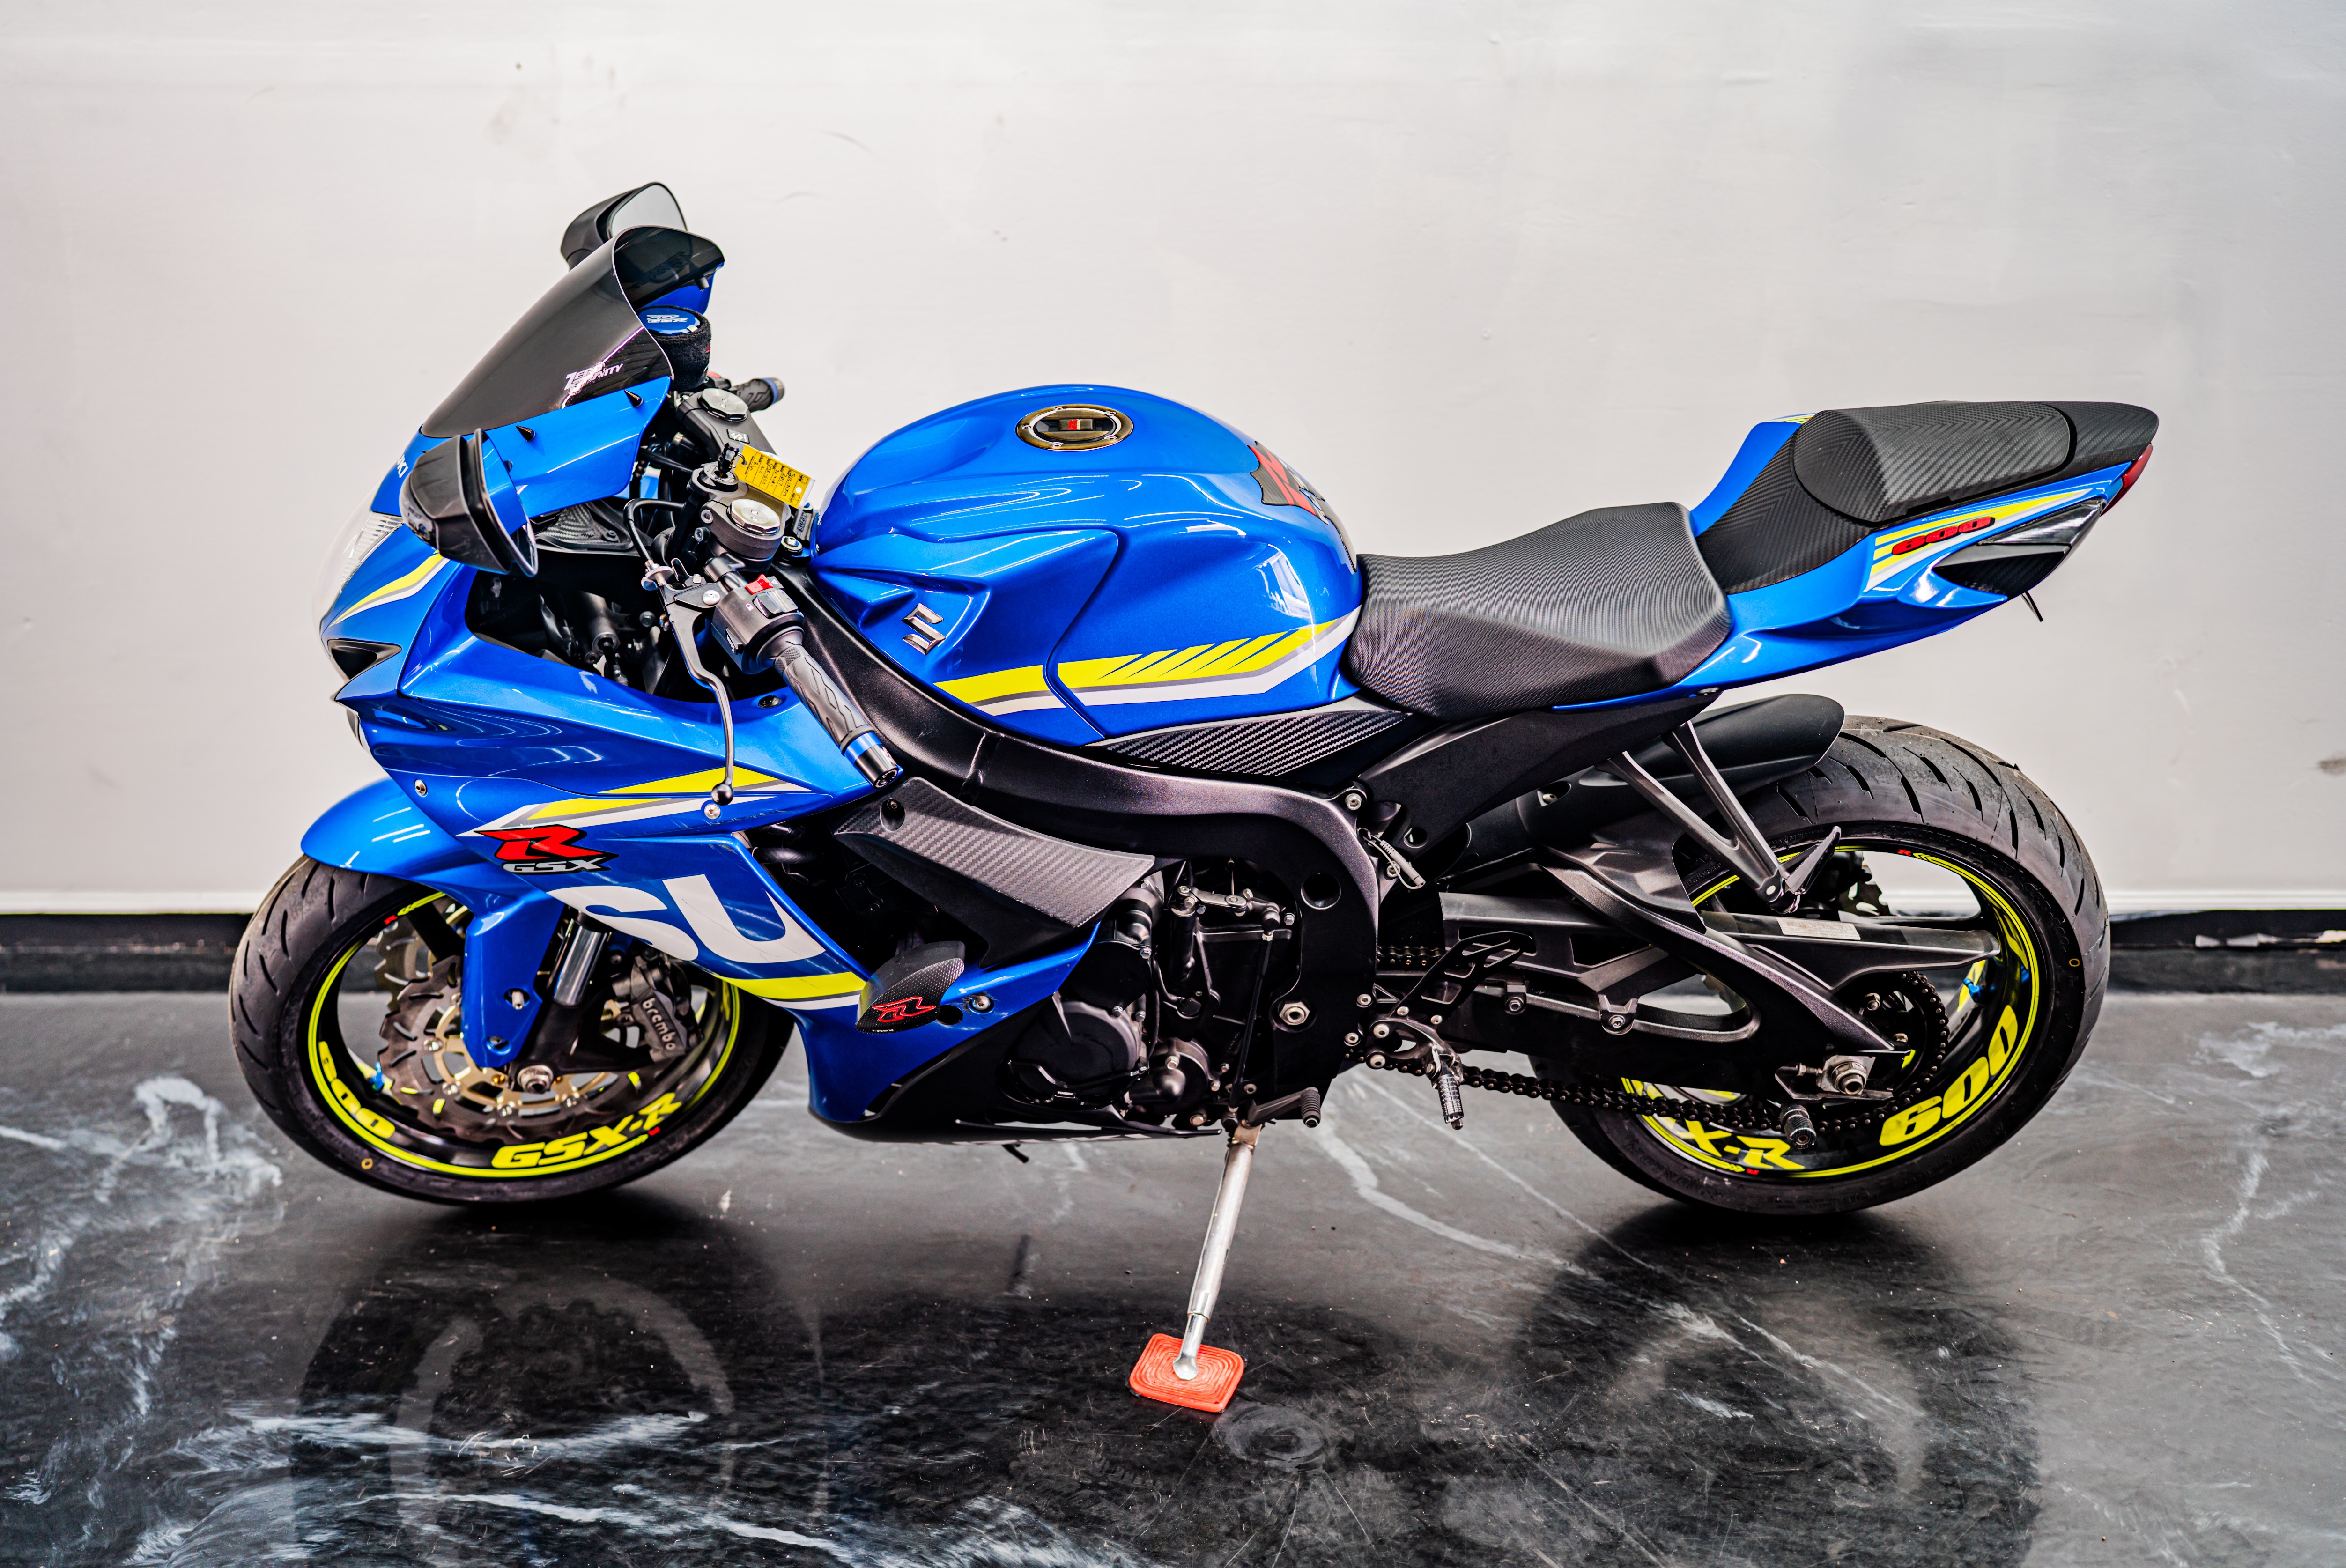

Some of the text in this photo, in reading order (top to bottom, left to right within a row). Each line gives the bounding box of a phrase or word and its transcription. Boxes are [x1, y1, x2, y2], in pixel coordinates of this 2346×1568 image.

[1891, 516, 1998, 555] 600
[475, 826, 605, 860] R
[503, 857, 605, 873] GSX
[547, 874, 826, 964] SU
[642, 998, 676, 1050] brembo
[318, 1041, 395, 1139] 600
[1879, 1005, 2018, 1146] 600
[492, 1092, 682, 1169] GSX-R
